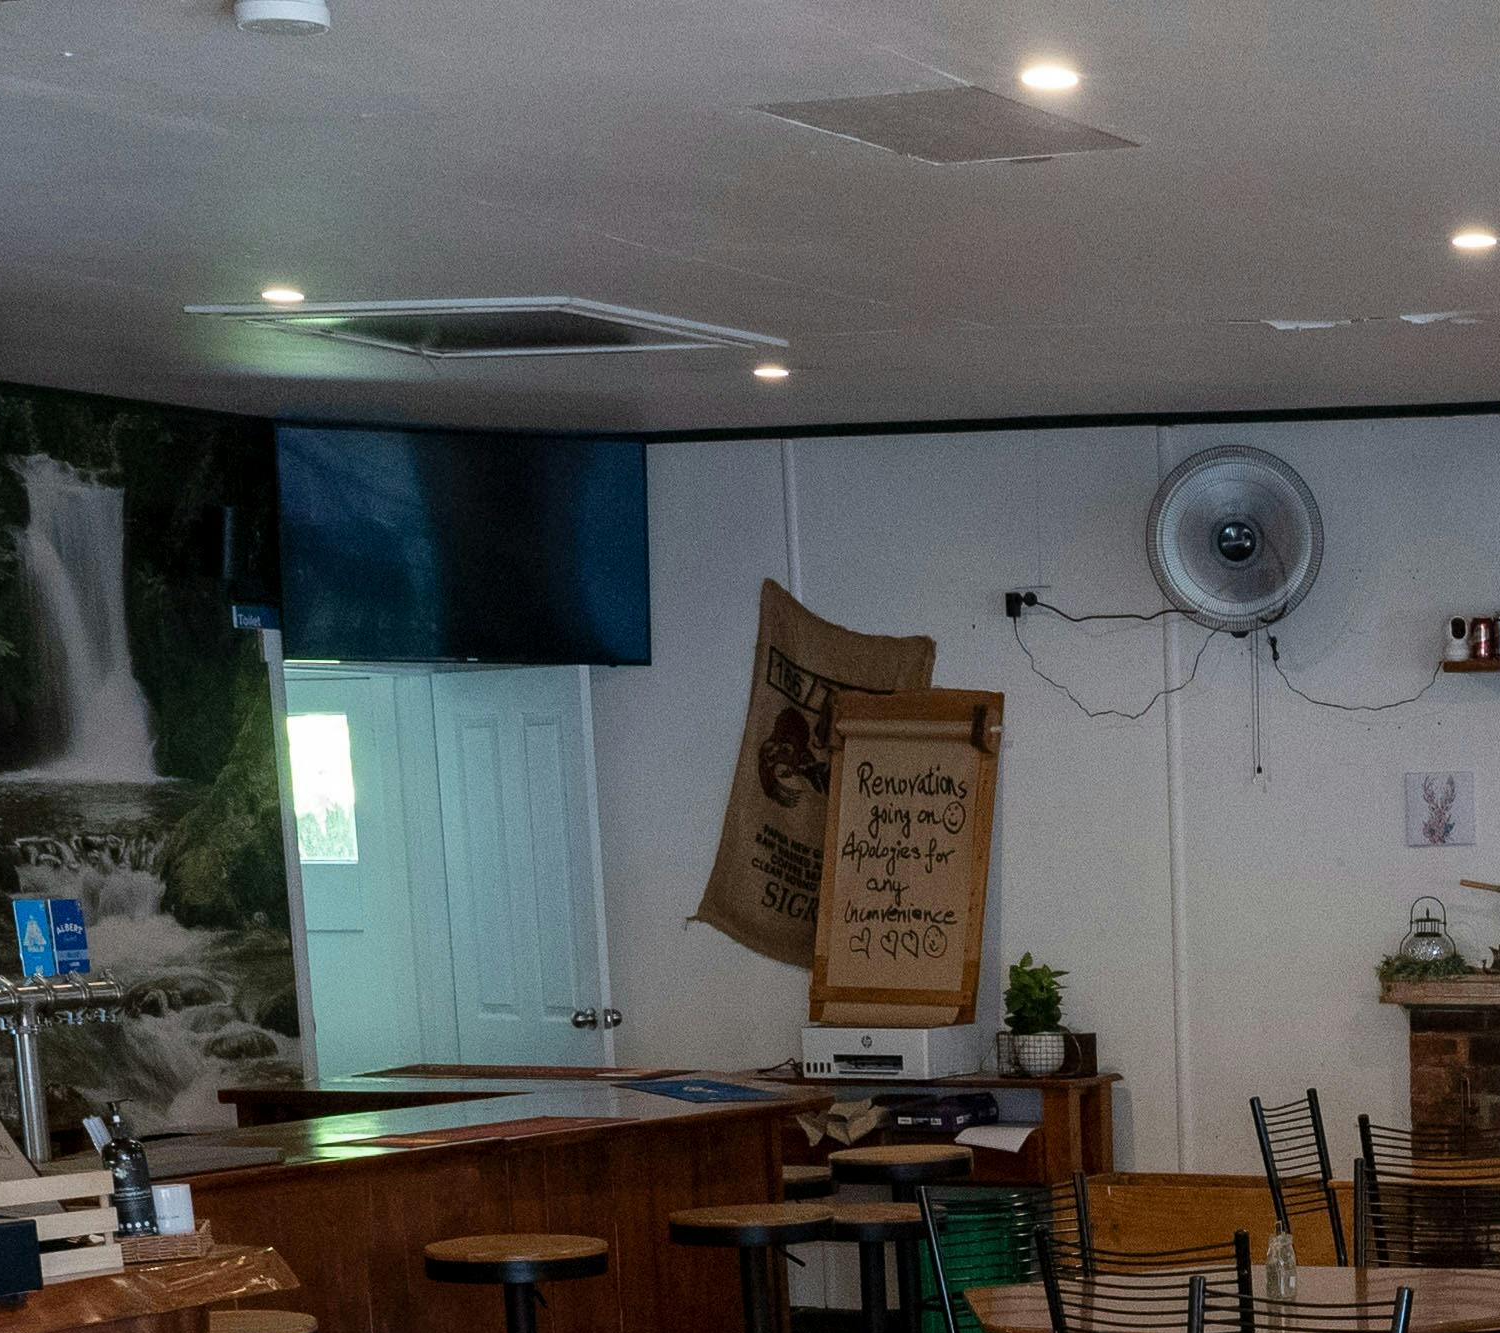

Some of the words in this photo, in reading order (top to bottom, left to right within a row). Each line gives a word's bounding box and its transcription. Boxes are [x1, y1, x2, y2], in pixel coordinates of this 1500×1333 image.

[856, 761, 968, 800] Renovations
[868, 803, 912, 839] going
[917, 808, 941, 825] on
[841, 831, 922, 876] Apologies
[925, 838, 956, 874] for
[866, 877, 910, 906] any
[56, 923, 84, 935] ALBERT
